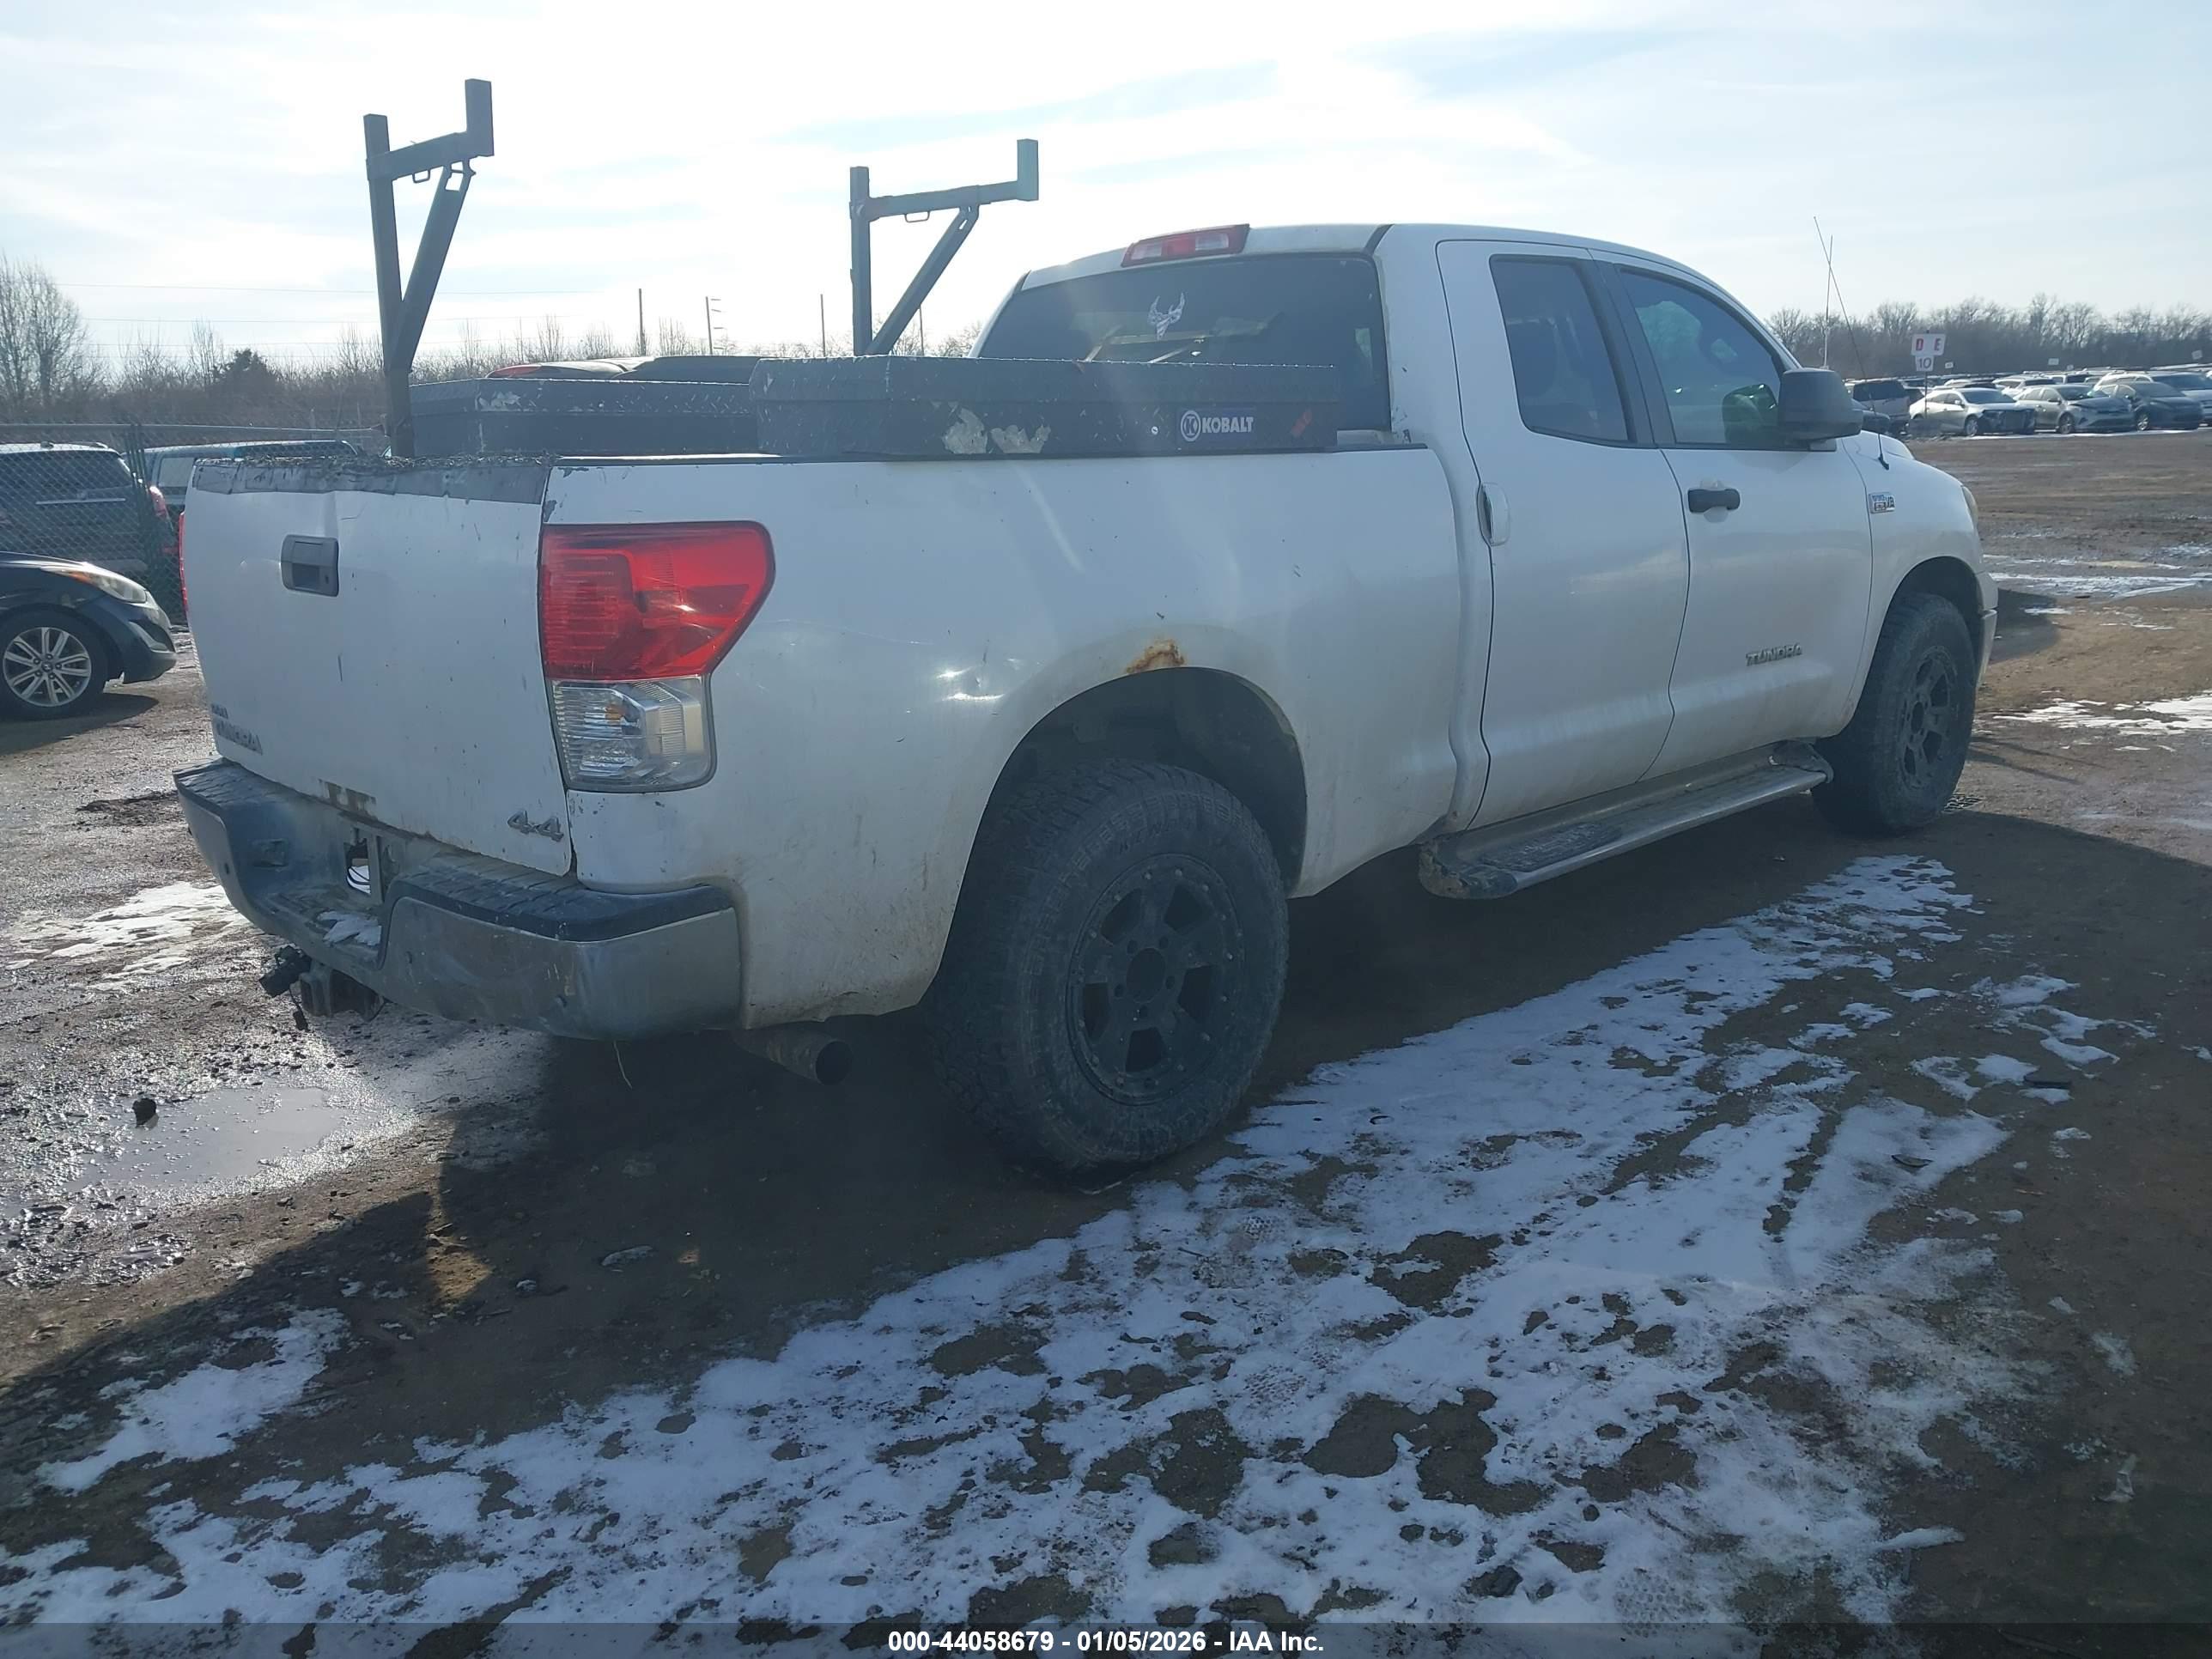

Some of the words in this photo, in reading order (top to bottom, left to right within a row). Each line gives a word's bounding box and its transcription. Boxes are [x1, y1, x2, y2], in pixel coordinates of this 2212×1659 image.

[1915, 337, 1924, 351] D
[1933, 337, 1942, 351] E
[1918, 357, 1932, 369] 10
[1202, 416, 1254, 434] KOBALT
